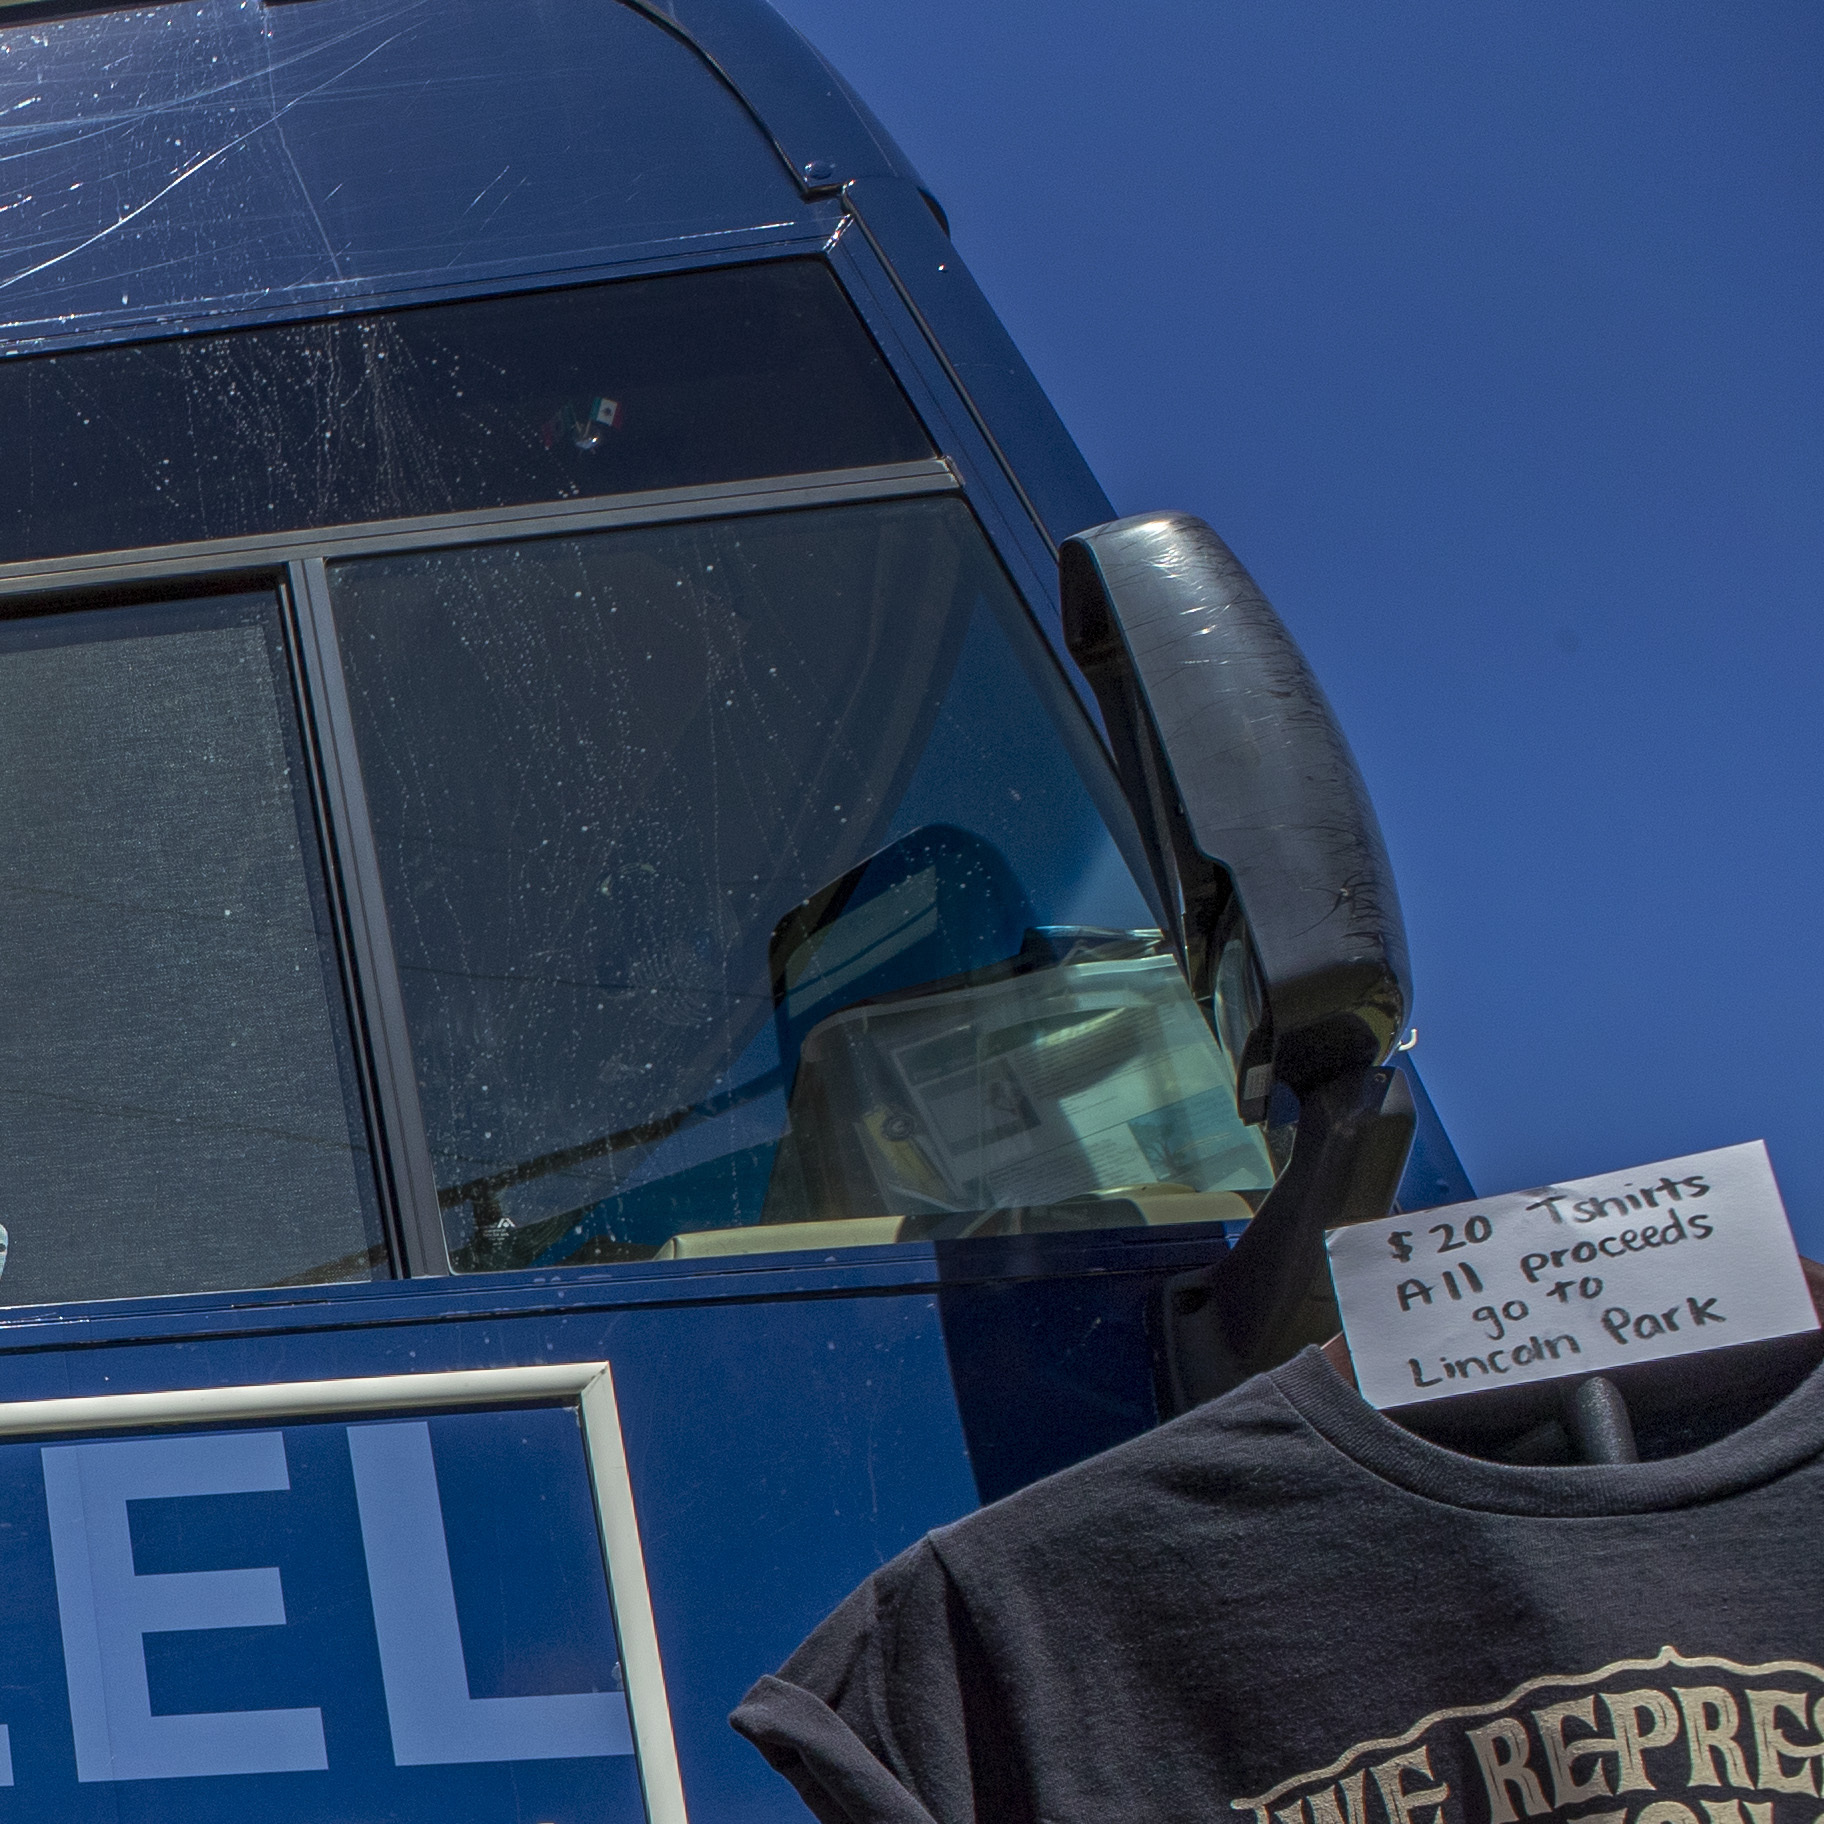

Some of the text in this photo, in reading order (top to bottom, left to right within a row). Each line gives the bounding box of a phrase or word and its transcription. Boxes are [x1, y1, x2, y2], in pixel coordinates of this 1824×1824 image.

[1387, 1215, 1493, 1263] $20
[1396, 1262, 1483, 1312] All
[1472, 1276, 1603, 1341] go to
[1601, 1297, 1726, 1345] Park
